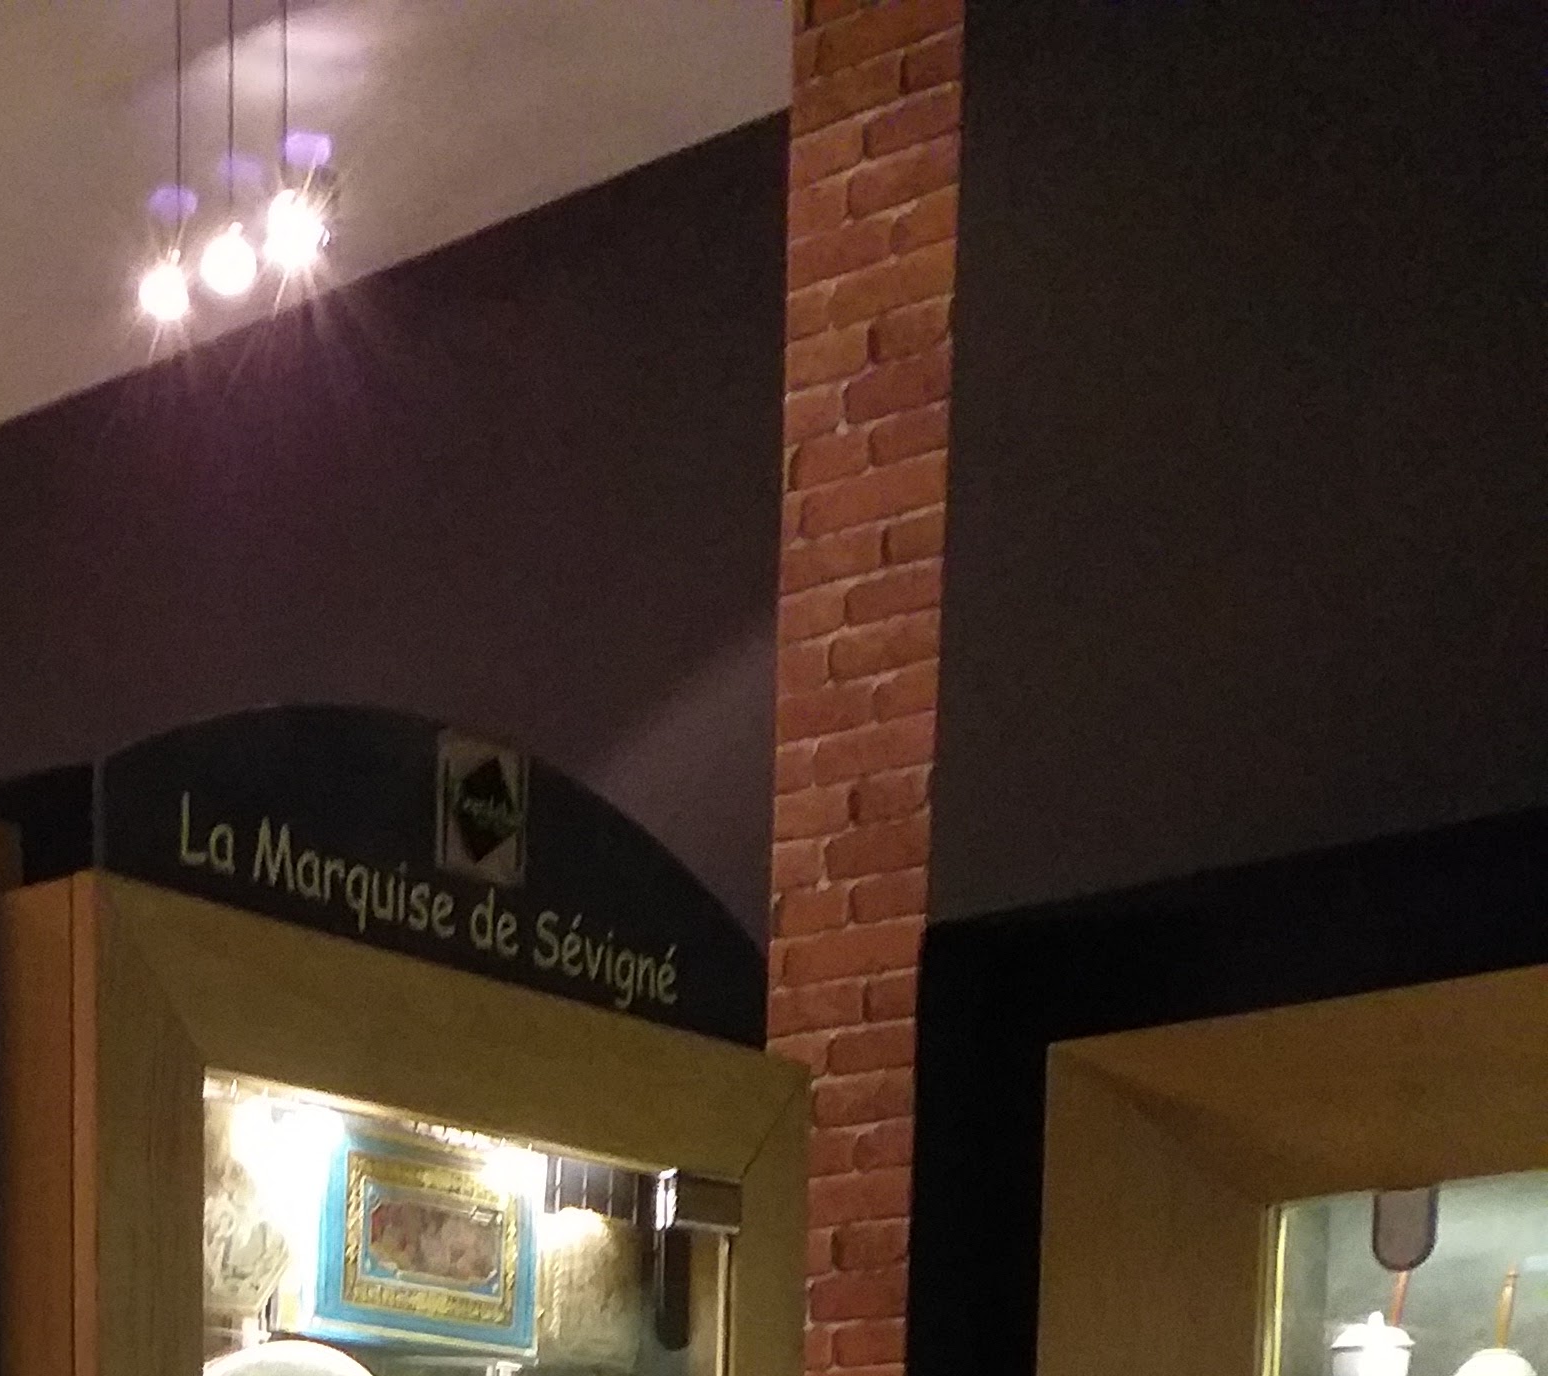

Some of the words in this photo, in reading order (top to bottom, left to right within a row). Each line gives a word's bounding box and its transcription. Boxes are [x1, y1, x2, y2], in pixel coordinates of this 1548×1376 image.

[178, 789, 236, 876] La
[252, 815, 456, 936] Marquise
[469, 887, 521, 957] de
[532, 909, 679, 1009] Sévigné
